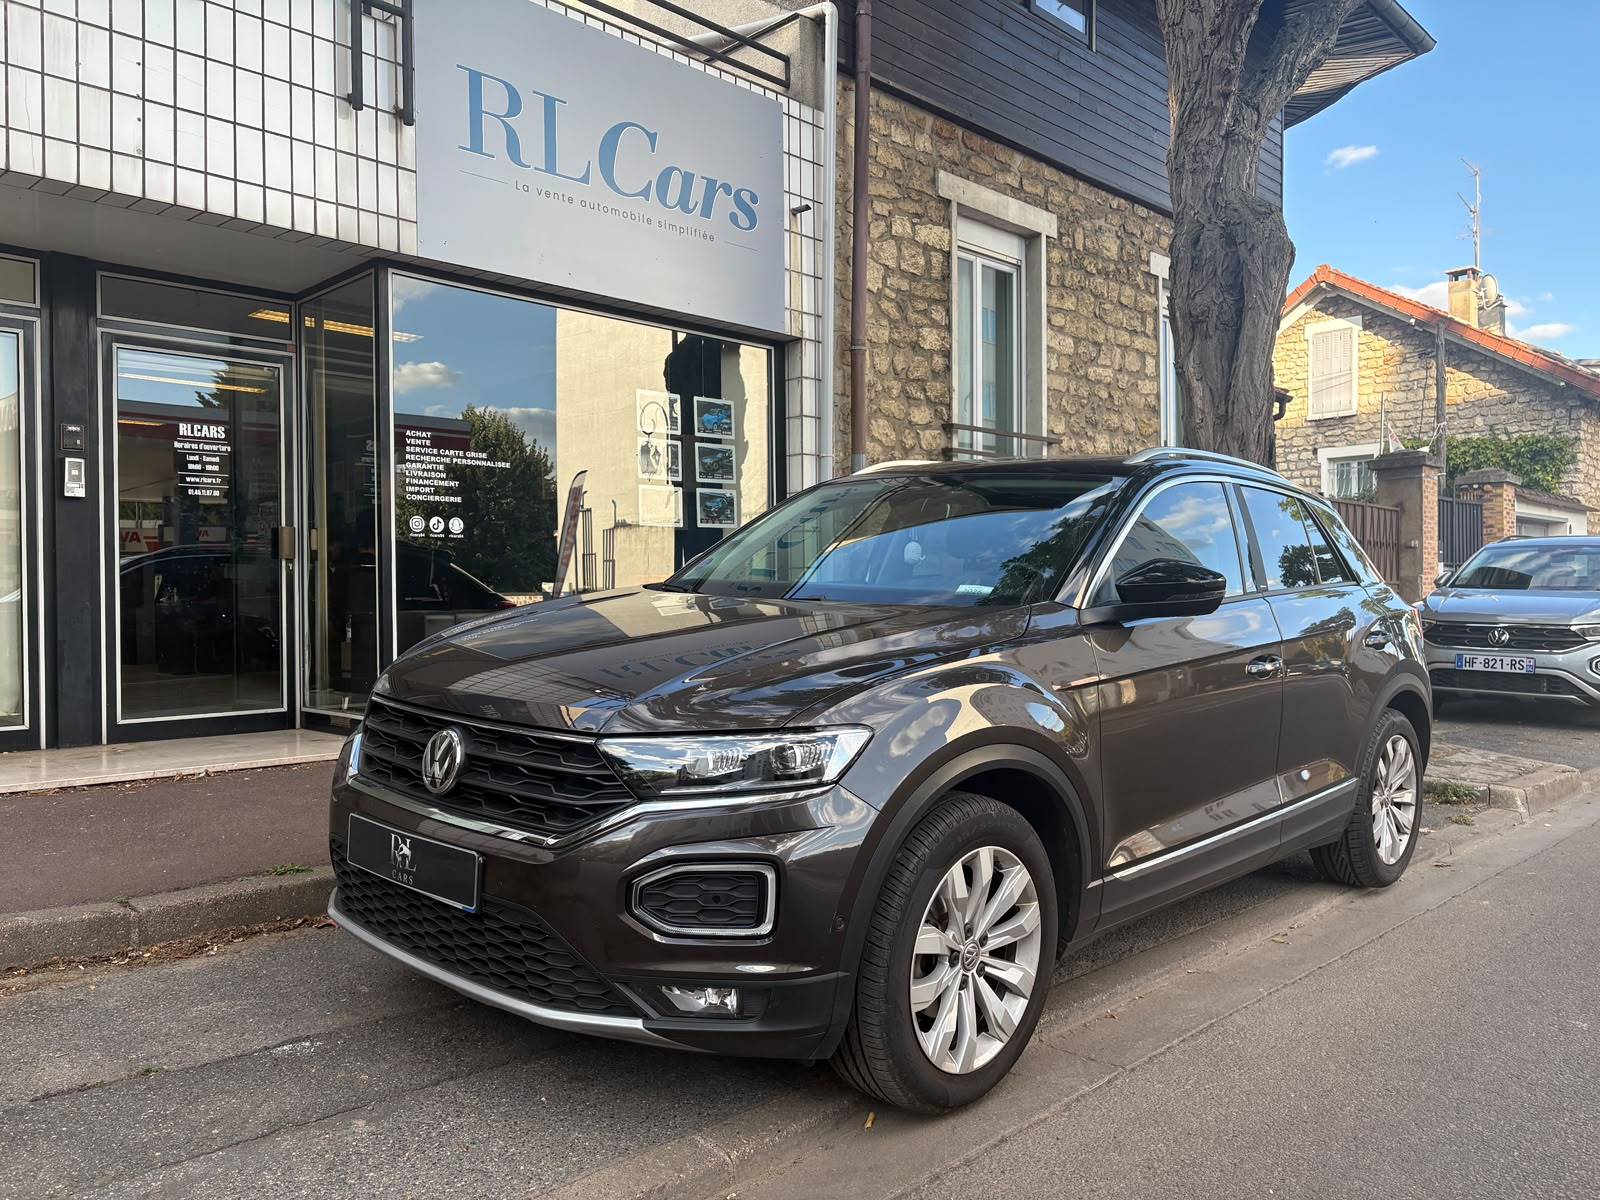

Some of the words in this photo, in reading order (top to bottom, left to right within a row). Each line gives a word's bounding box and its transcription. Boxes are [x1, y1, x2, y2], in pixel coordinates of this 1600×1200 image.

[515, 180, 530, 193] La
[536, 187, 574, 205] vente
[580, 199, 653, 226] automobile
[657, 219, 716, 243] simplifiée
[179, 423, 226, 439] RLCARS
[406, 430, 432, 438] ACHAT
[406, 438, 431, 446] VENTE
[406, 446, 438, 455] SERVICE
[440, 449, 464, 457] CARTE
[466, 451, 488, 459] GRISE
[406, 454, 451, 464] RECHERCHE
[406, 462, 445, 471] GARANTIE
[406, 470, 447, 479] LIVRAISON
[406, 478, 459, 487] FINANCEMENT
[406, 486, 436, 494] IMPORT
[406, 494, 462, 502] CONCIERGERIE
[391, 870, 413, 884] CARS
